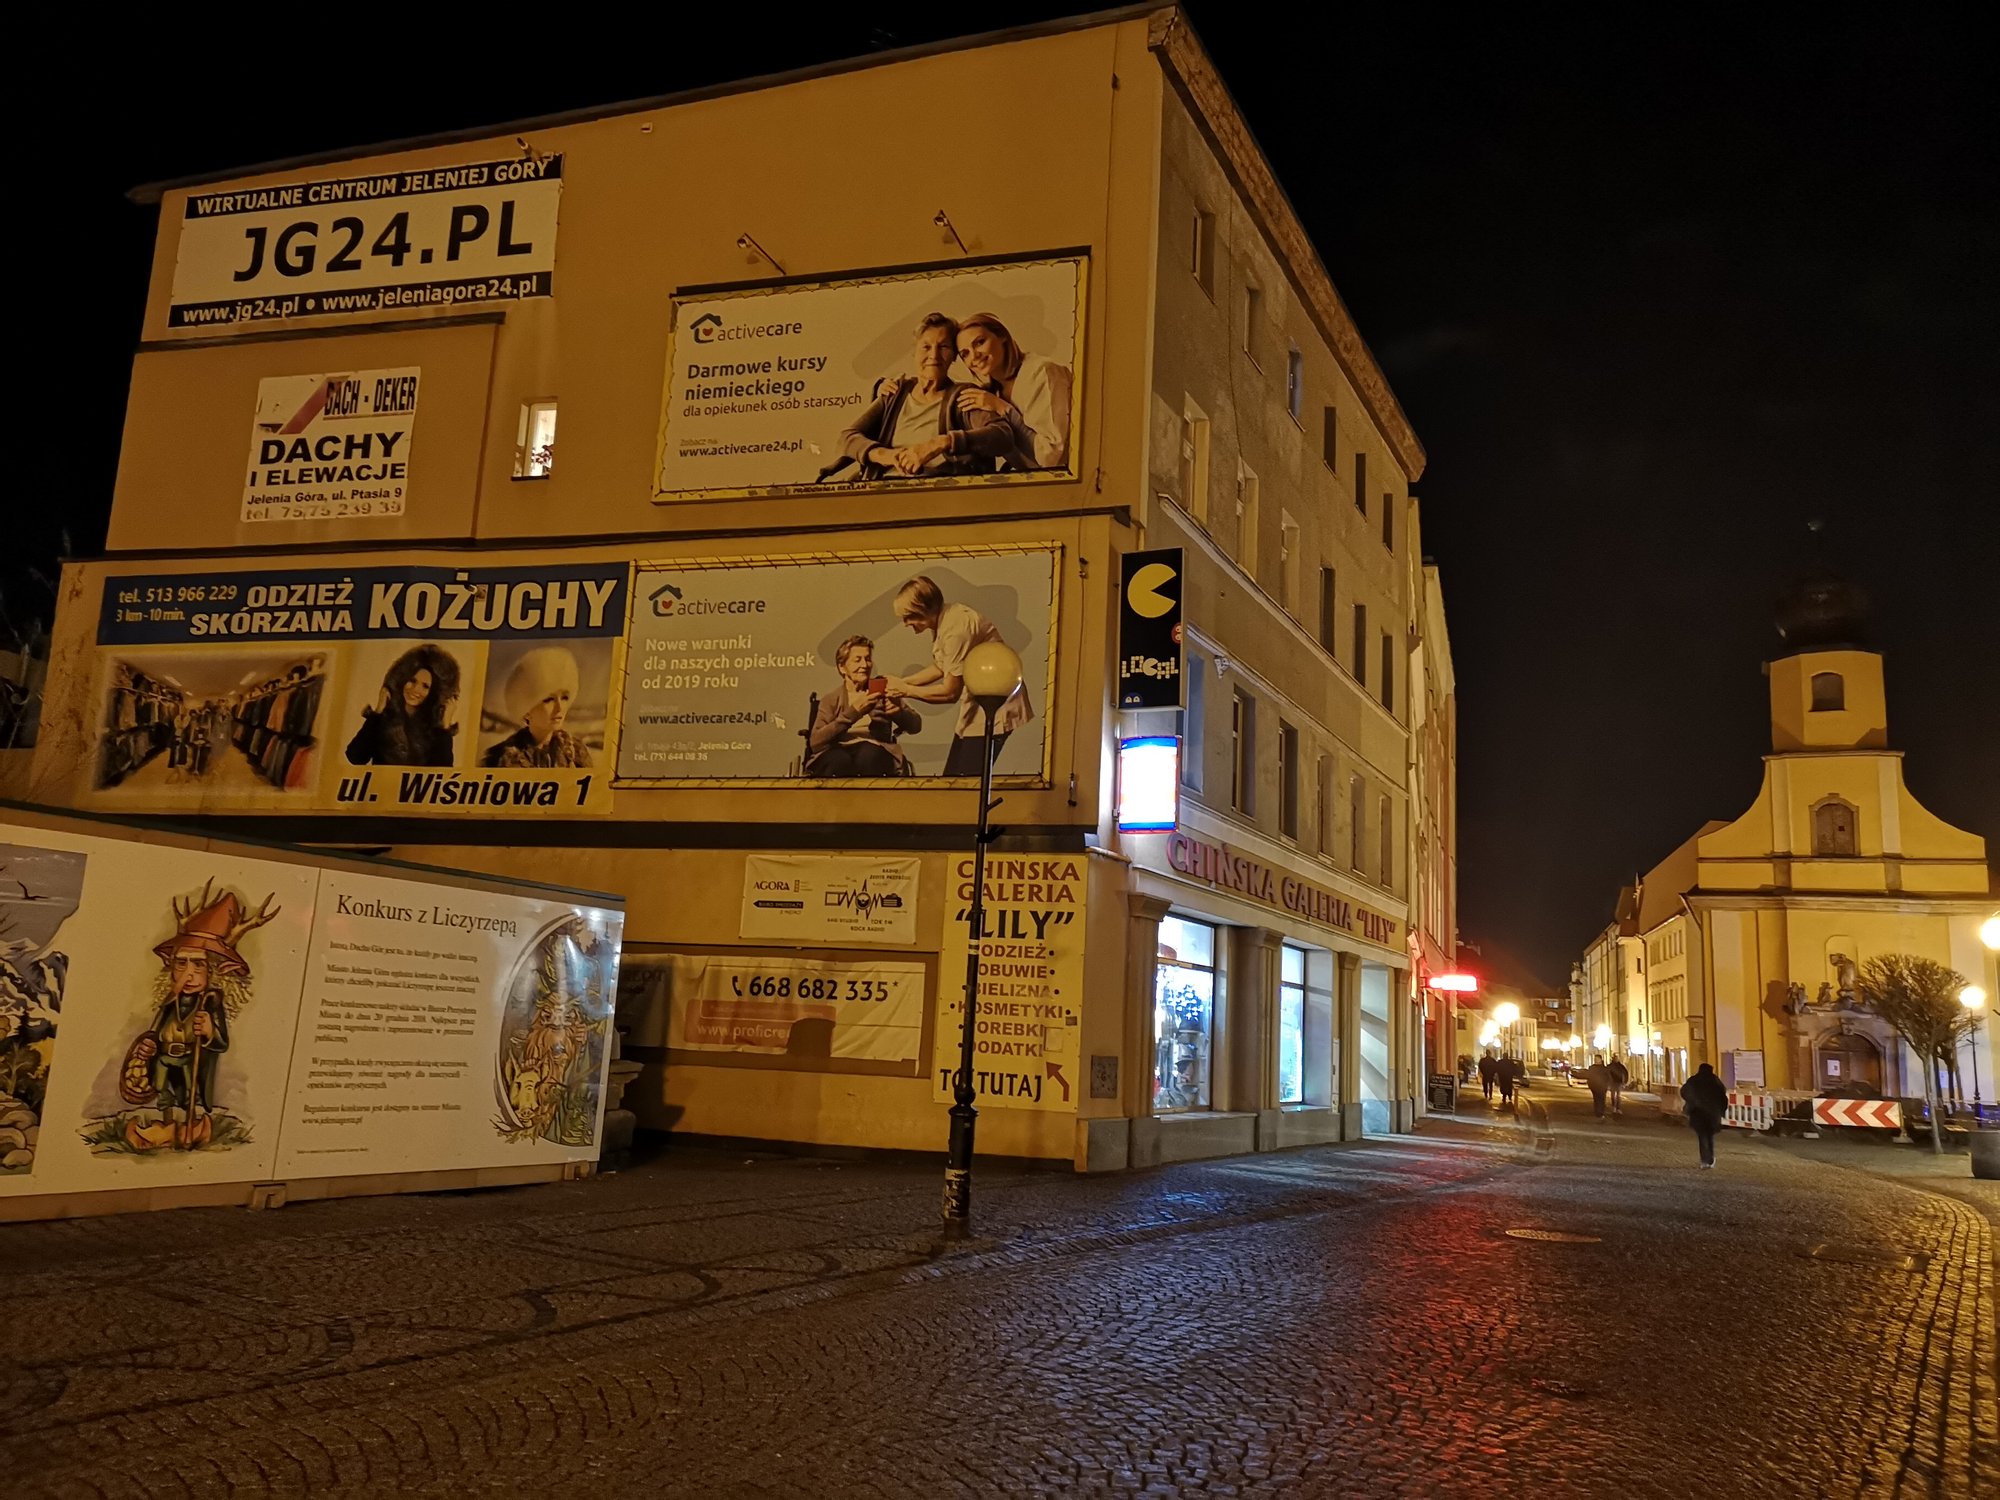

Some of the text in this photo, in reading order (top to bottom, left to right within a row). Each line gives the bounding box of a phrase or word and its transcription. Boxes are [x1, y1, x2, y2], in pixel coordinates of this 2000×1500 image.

[197, 160, 549, 214] WIRTUALNE CENTRUM JELENIEJ GÓRY
[233, 200, 532, 282] JG24.PL
[183, 275, 537, 322] www.jg24.pl www.jeleniagora24.pl
[717, 321, 802, 342] activecare
[688, 355, 827, 379] Darmowe kursy
[324, 380, 361, 416] DACH
[373, 376, 417, 412] DEKER
[685, 378, 805, 400] niemieckiego
[683, 392, 862, 417] dla opiekunek osób starszych
[259, 431, 404, 465] DACHY
[679, 439, 803, 457] www.activecare24.pl
[250, 463, 406, 487] I ELEWACJE
[247, 494, 291, 505] Jelenia
[332, 490, 346, 500] ul.
[351, 487, 390, 500] Ptasia
[394, 487, 402, 498] 9
[119, 585, 238, 603] tel. 513 966 229
[246, 572, 618, 630] ODZIEŻ KOŻUCHY
[677, 598, 766, 615] activecare
[189, 606, 353, 635] SKÓRZANA
[645, 634, 751, 652] Nowe warunki
[643, 652, 815, 672] dla naszych opiekunek
[642, 674, 739, 689] od 2019 roku
[639, 711, 767, 725] www.activecare24.pl
[337, 771, 592, 806] ul. Wiśniowa 1
[753, 881, 790, 891] AGORA
[1167, 832, 1277, 904] CHIŃSKA
[1281, 876, 1353, 931] GALERIA
[958, 882, 1075, 903] GALERIA
[336, 894, 516, 937] Konkurs z Liczyrzepą
[981, 943, 1046, 959] ODZIEŻ
[979, 963, 1047, 978] OBUWIE
[749, 976, 791, 997] 668
[797, 978, 838, 1000] 682
[697, 1024, 790, 1041] www.proficre
[975, 1021, 1044, 1037] OREBKI
[972, 1041, 1043, 1057] ODATKI
[977, 1071, 1042, 1102] TUTAJ
